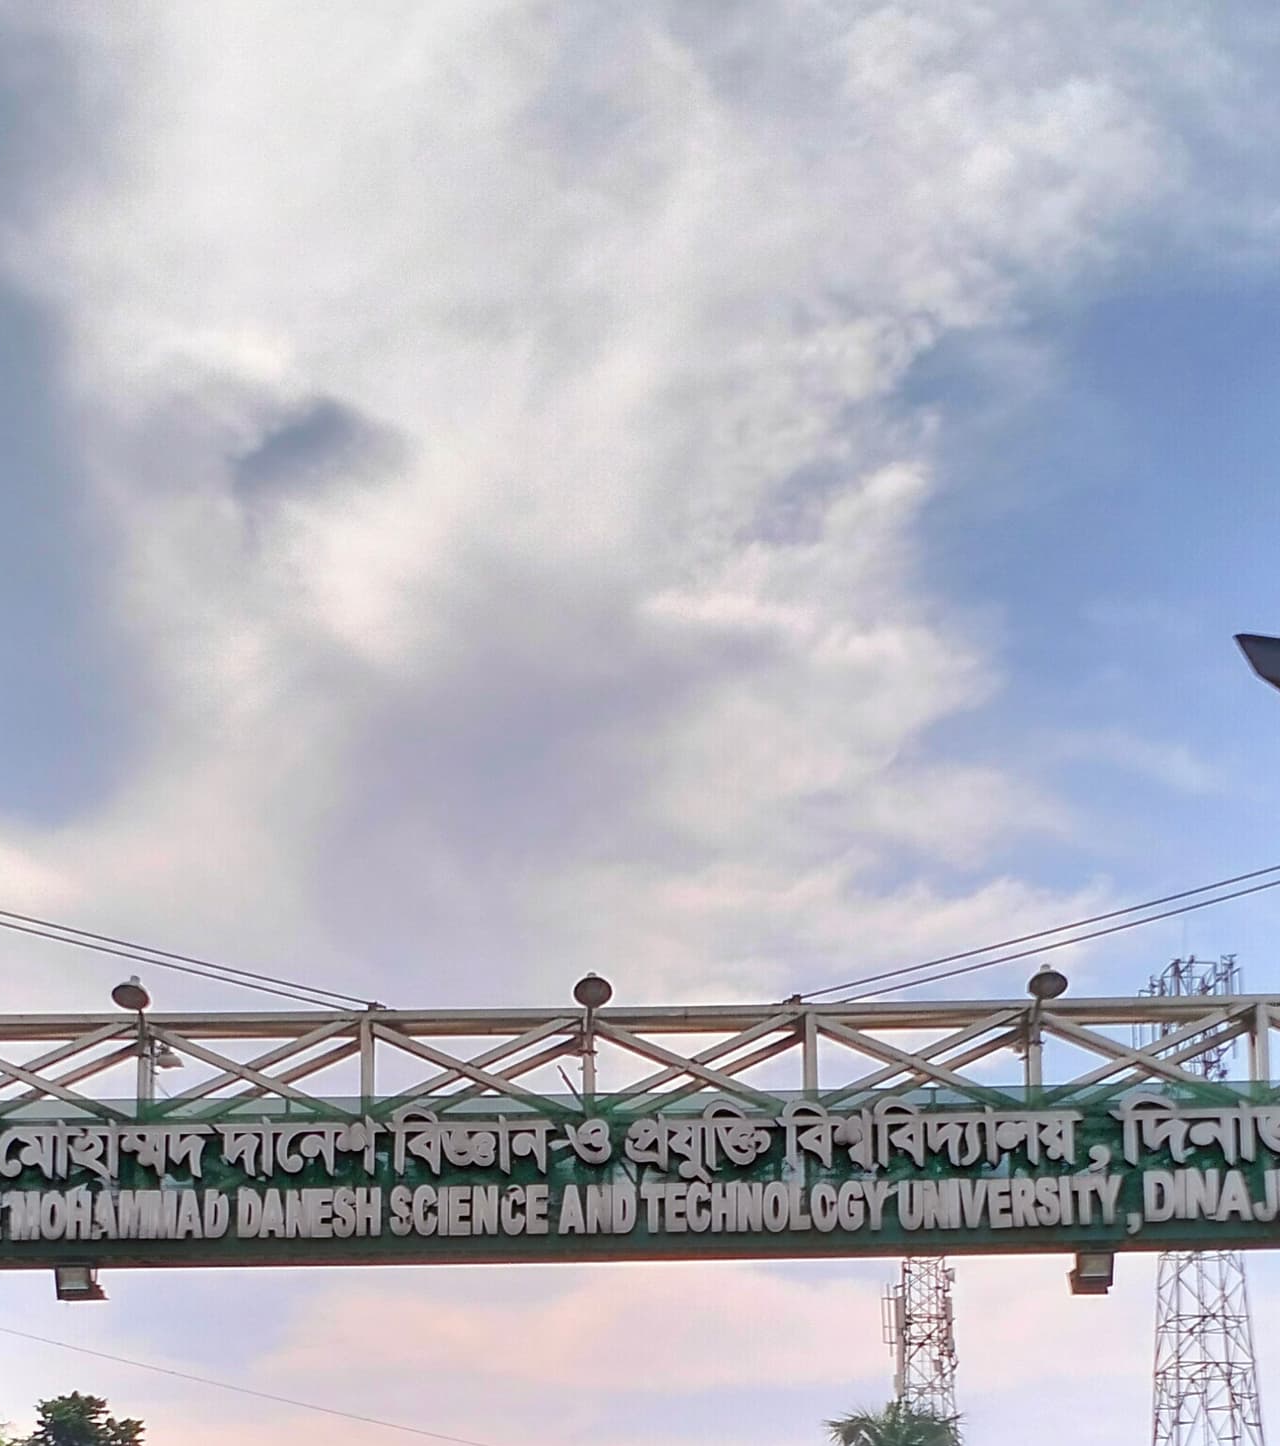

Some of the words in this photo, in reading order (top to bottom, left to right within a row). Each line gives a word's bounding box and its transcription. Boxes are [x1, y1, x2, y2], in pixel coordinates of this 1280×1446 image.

[214, 1113, 387, 1177] দানেশ
[386, 1105, 554, 1176] বিজ্ঞান
[565, 1118, 612, 1165] ও
[625, 1101, 777, 1183] প্রযুক্তি
[6, 1189, 229, 1240] MOHAMMAD
[237, 1187, 382, 1239] DANESH
[390, 1185, 549, 1237] SCIENCE
[558, 1183, 637, 1235] AND
[641, 1180, 888, 1233] TECHNOLOGY
